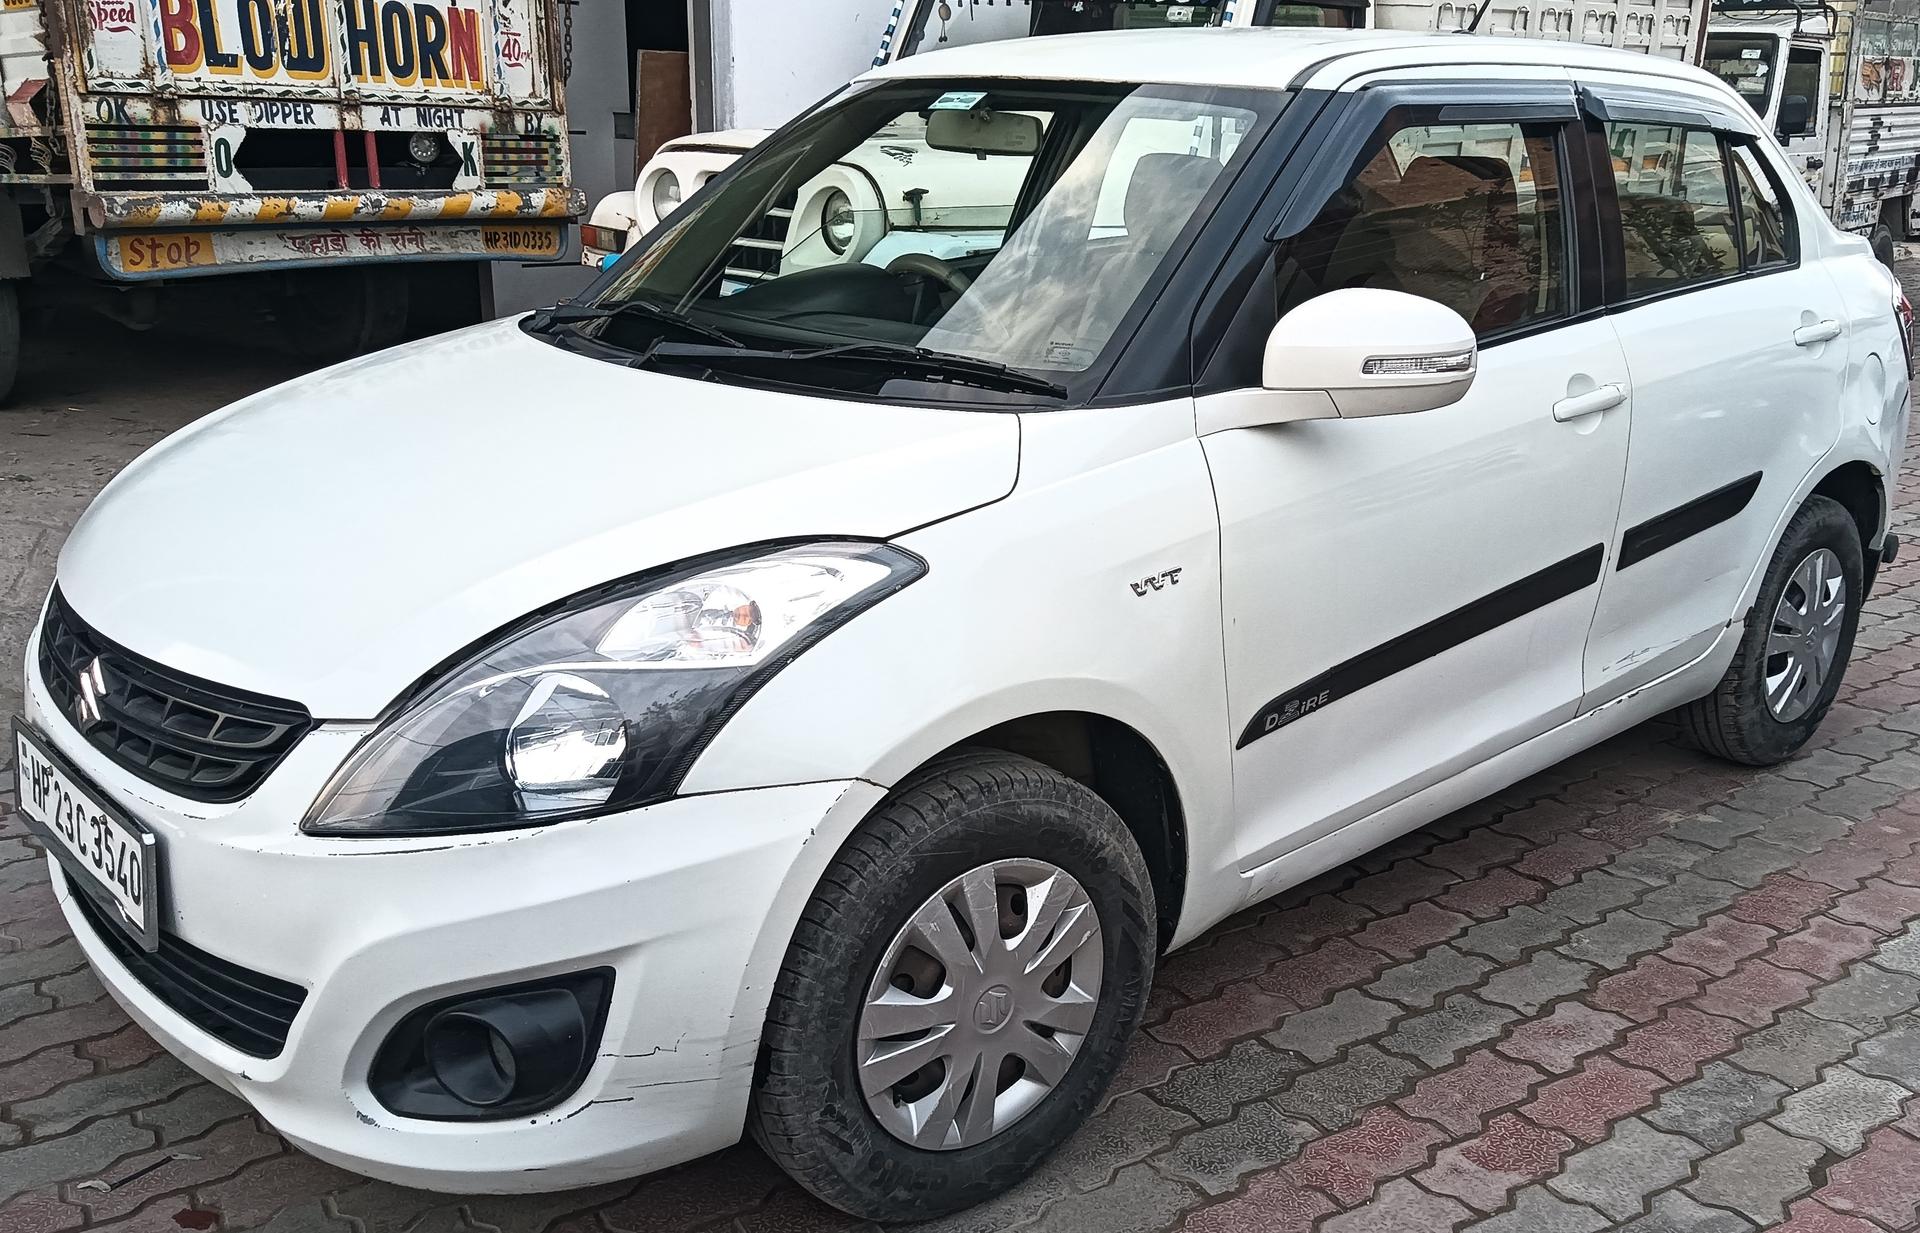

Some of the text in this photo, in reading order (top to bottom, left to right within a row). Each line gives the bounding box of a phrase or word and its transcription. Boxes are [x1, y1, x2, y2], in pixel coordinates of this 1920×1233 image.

[88, 1, 136, 31] Speed
[160, 0, 484, 89] BLOW HORN
[95, 97, 132, 125] OK
[200, 99, 465, 128] USE DIPPER AT NIGHT
[128, 235, 201, 269] Stop
[54, 780, 75, 843] 23
[76, 803, 88, 857] C
[90, 815, 142, 906] 3540
